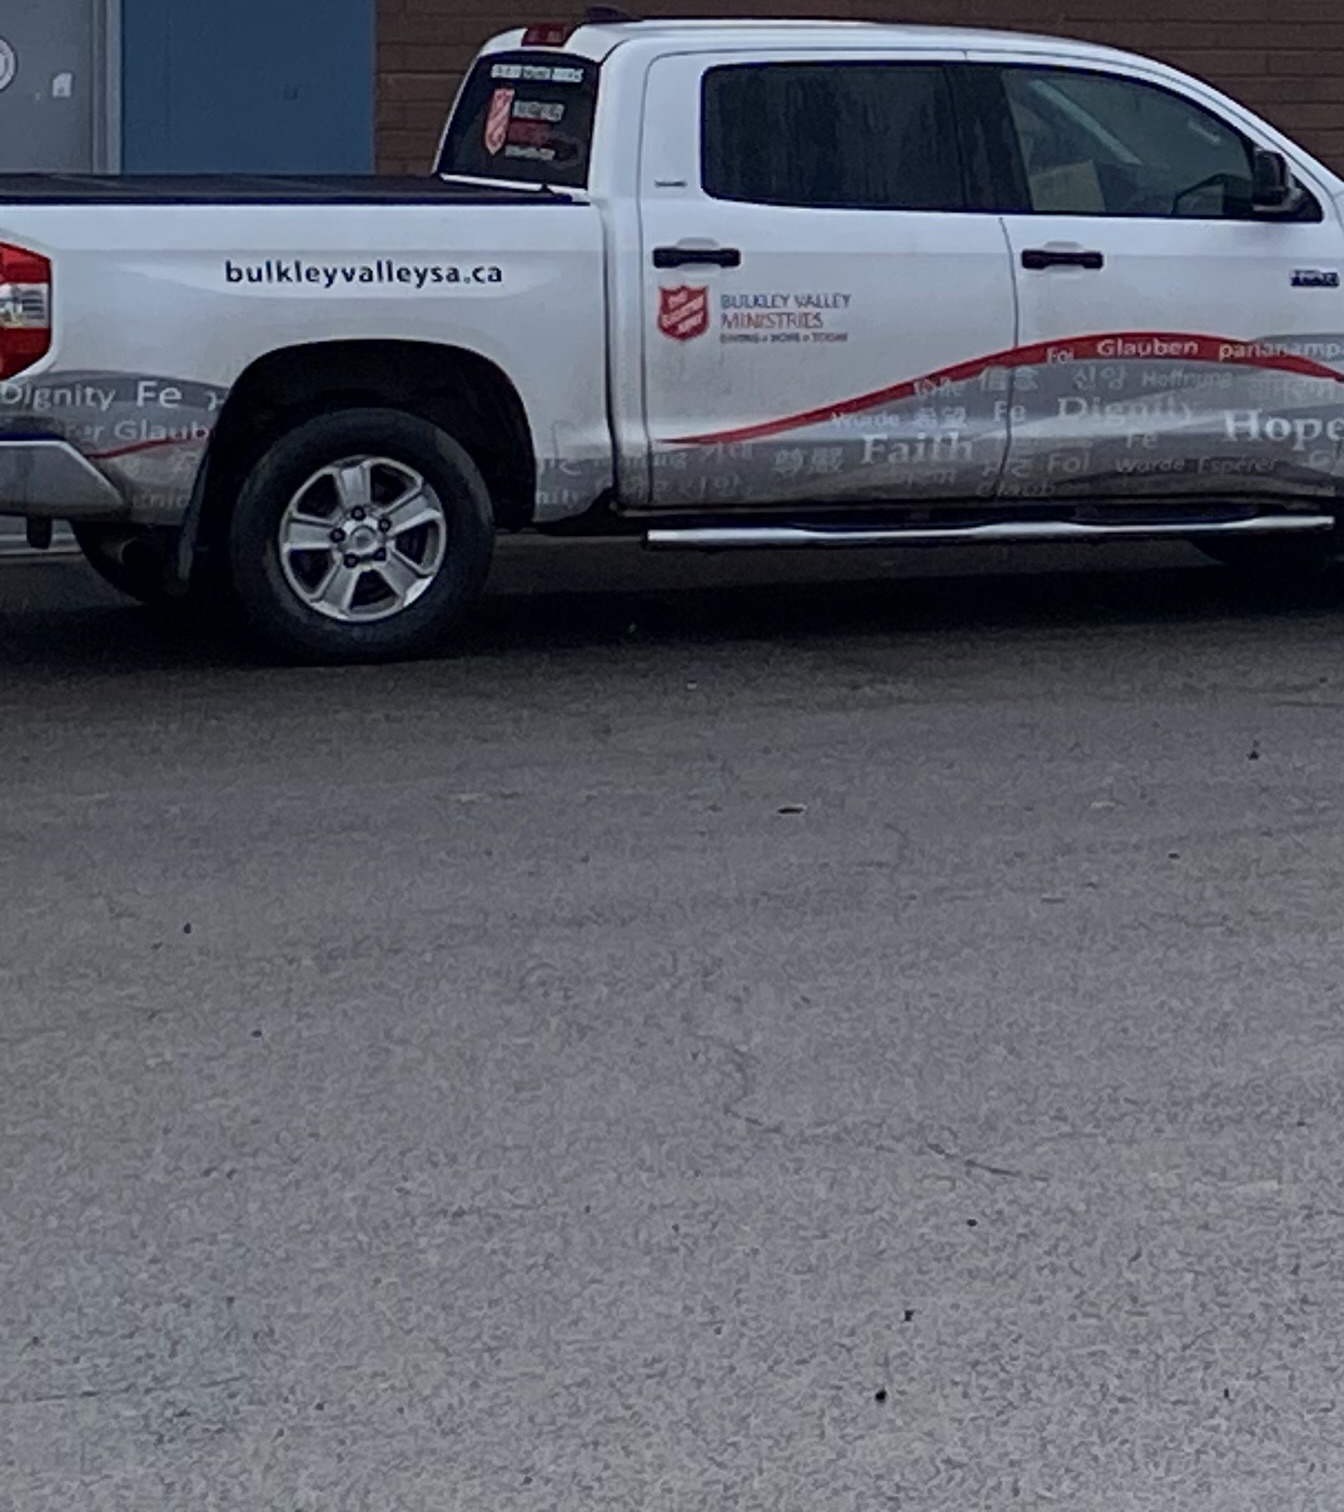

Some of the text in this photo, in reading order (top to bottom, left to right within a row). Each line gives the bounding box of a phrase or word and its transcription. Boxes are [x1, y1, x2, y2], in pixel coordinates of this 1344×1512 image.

[225, 259, 504, 290] bulkleyvalleysa.ca
[720, 294, 852, 310] BULKLEY VALLEY
[720, 312, 824, 330] MINISTRIES
[1096, 338, 1199, 358] Glauben
[0, 381, 116, 412] Dignity
[135, 380, 183, 408] Fe
[993, 400, 1027, 423] Fe
[859, 432, 974, 466] Faith
[1047, 451, 1091, 476] Foi
